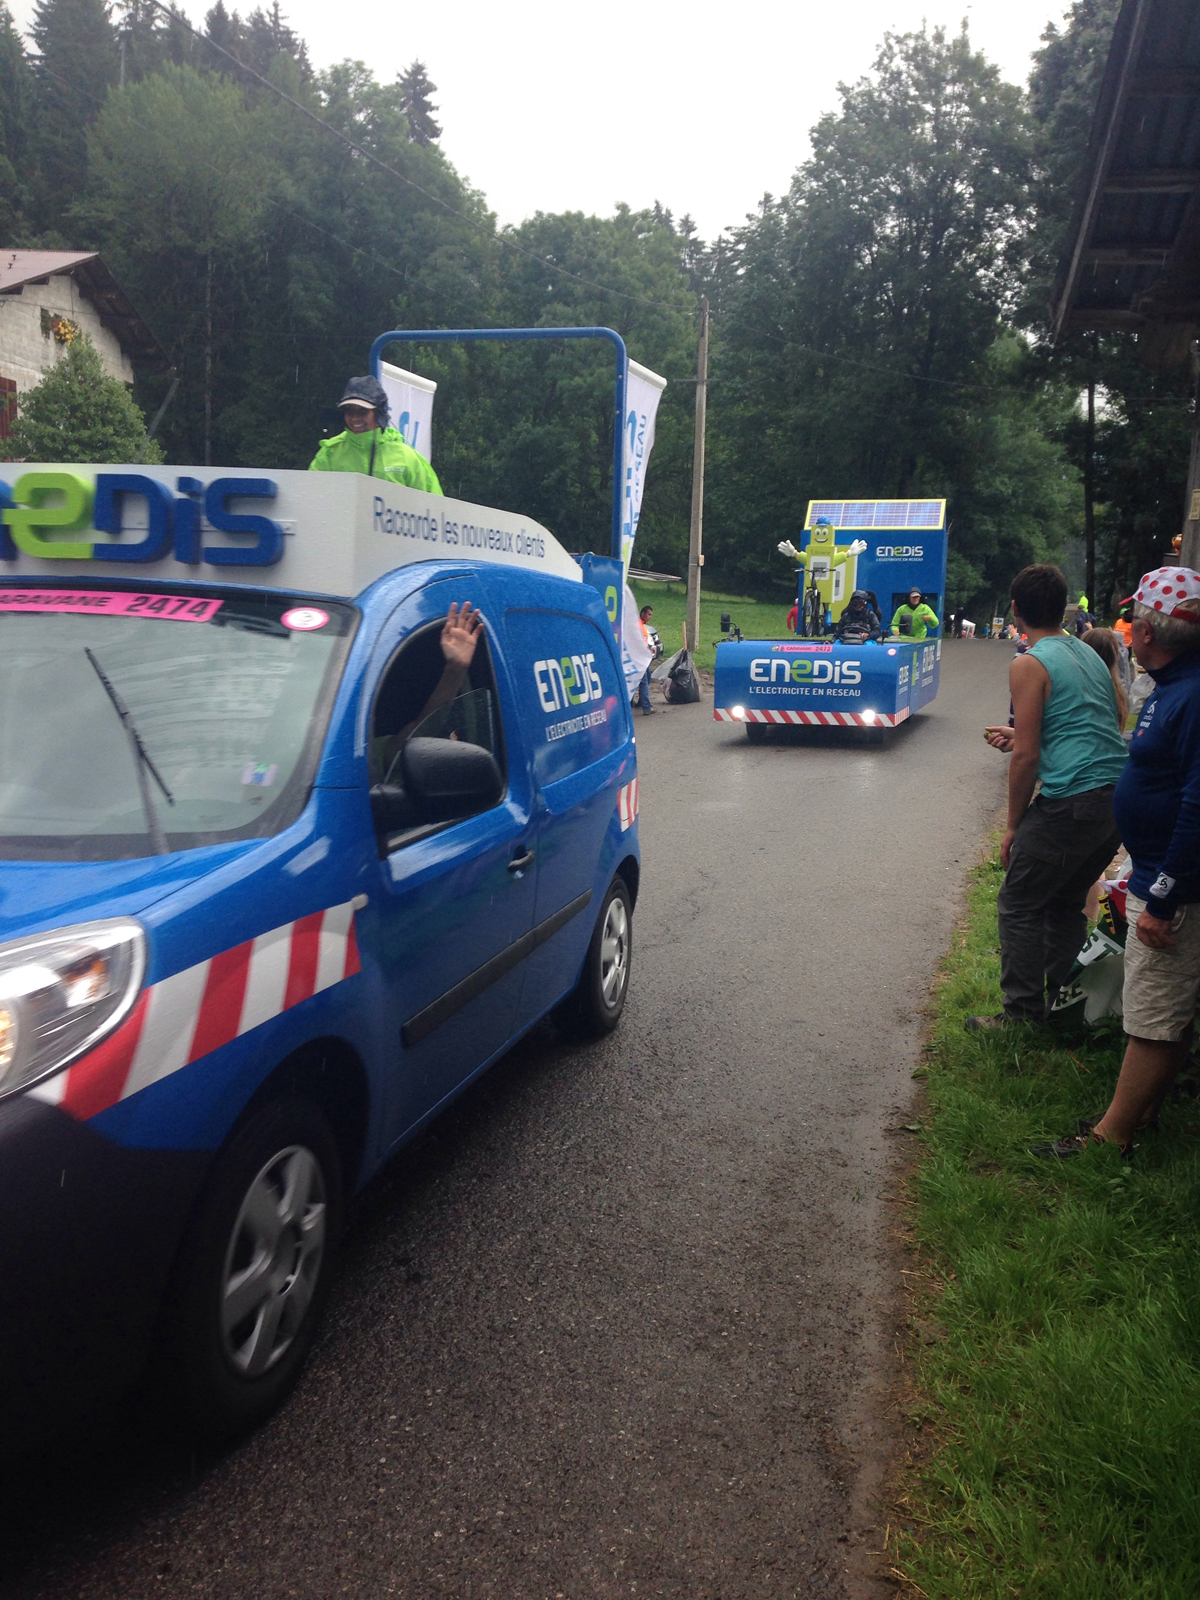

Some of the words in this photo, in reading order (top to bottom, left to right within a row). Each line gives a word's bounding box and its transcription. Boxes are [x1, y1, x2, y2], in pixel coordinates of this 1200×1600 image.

[373, 495, 438, 542] Raccorde
[441, 511, 459, 545] les
[462, 523, 514, 553] nouveaux
[516, 528, 546, 558] clients
[125, 595, 213, 618] 2474
[749, 686, 810, 696] L'ELECTRICITE
[812, 687, 825, 696] EN
[826, 688, 861, 697] RESEAU
